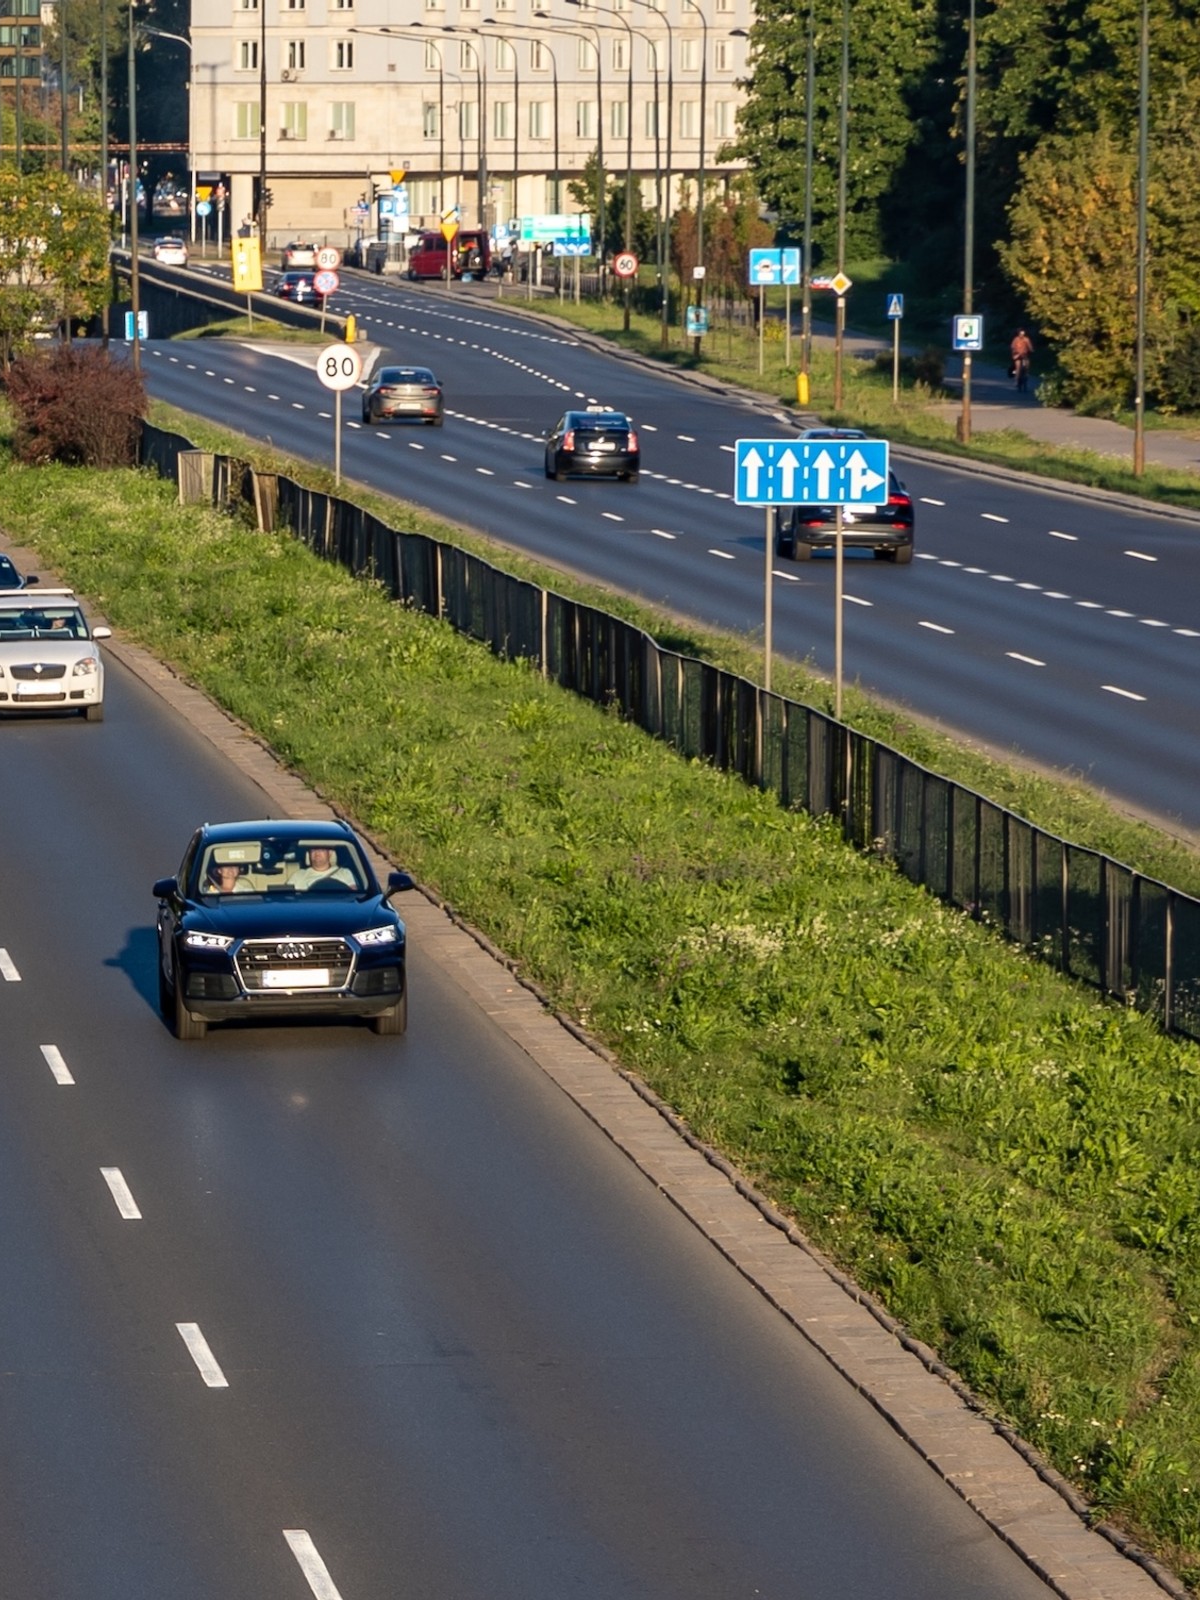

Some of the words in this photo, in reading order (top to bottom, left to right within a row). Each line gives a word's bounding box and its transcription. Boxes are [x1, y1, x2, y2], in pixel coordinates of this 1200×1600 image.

[320, 253, 336, 264] 80
[618, 259, 634, 271] 60
[325, 357, 354, 377] 80
